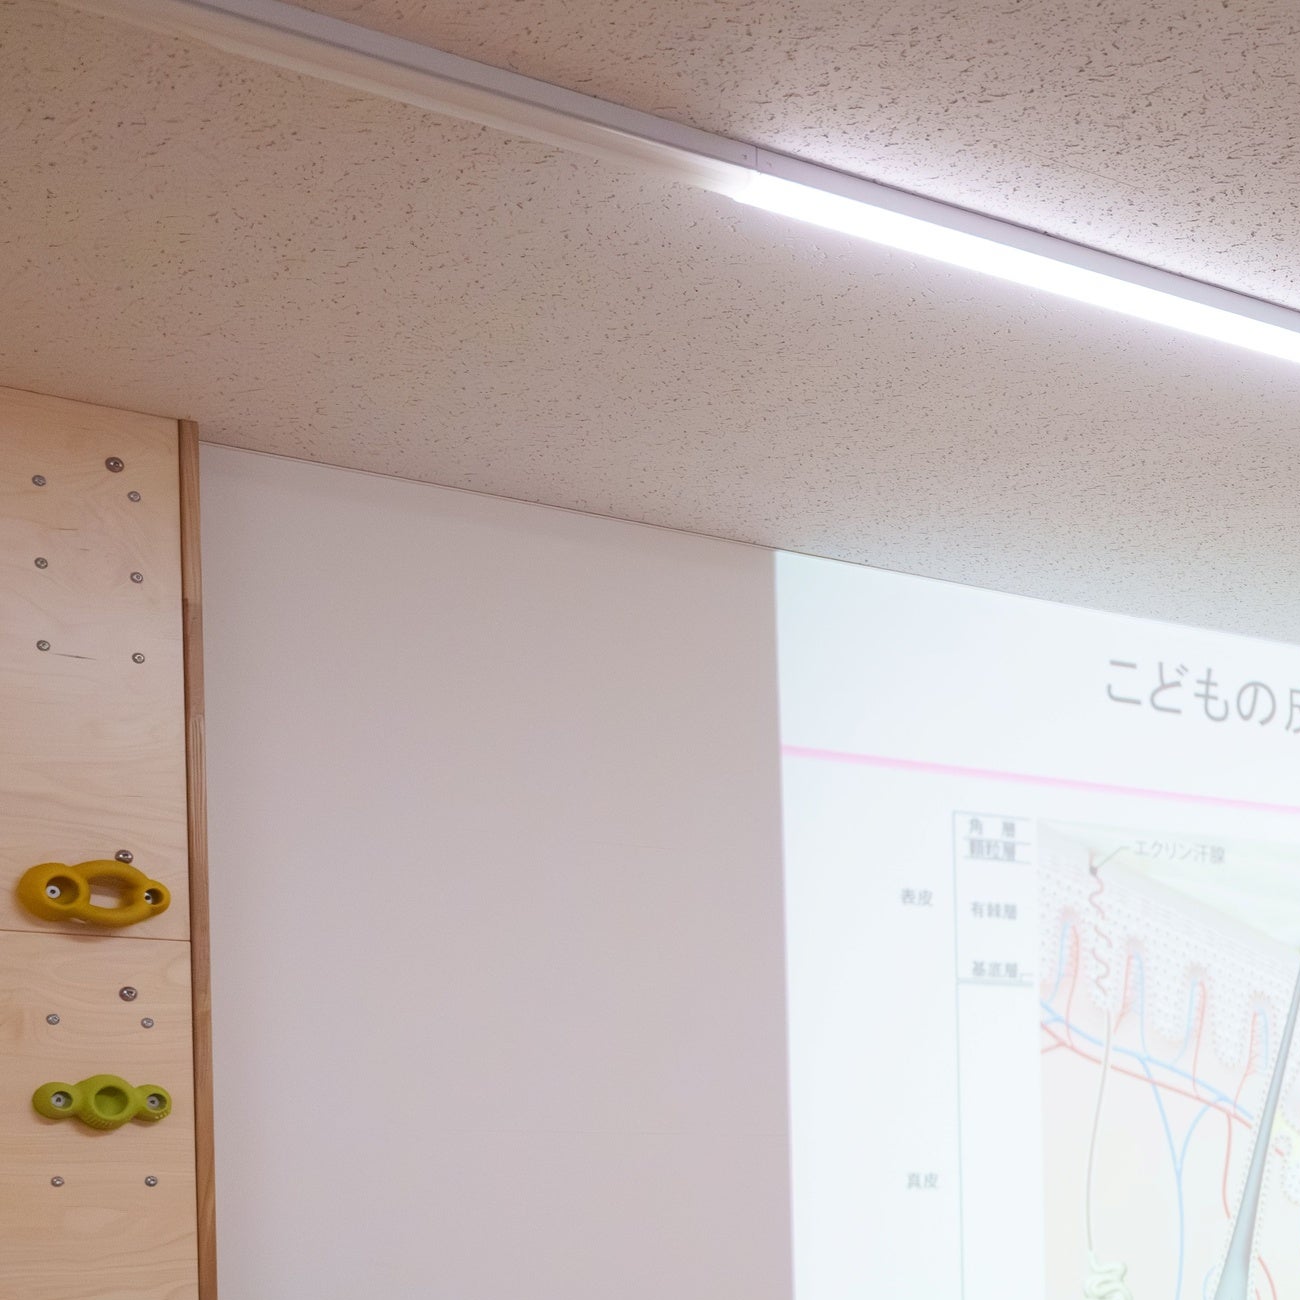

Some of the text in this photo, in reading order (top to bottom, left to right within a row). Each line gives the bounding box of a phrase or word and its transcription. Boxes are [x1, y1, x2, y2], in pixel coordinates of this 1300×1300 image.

[1133, 840, 1227, 865] エクリン汗腺
[899, 887, 935, 907] 表皮
[971, 960, 1018, 979] 基底層
[905, 1171, 939, 1190] 真皮
